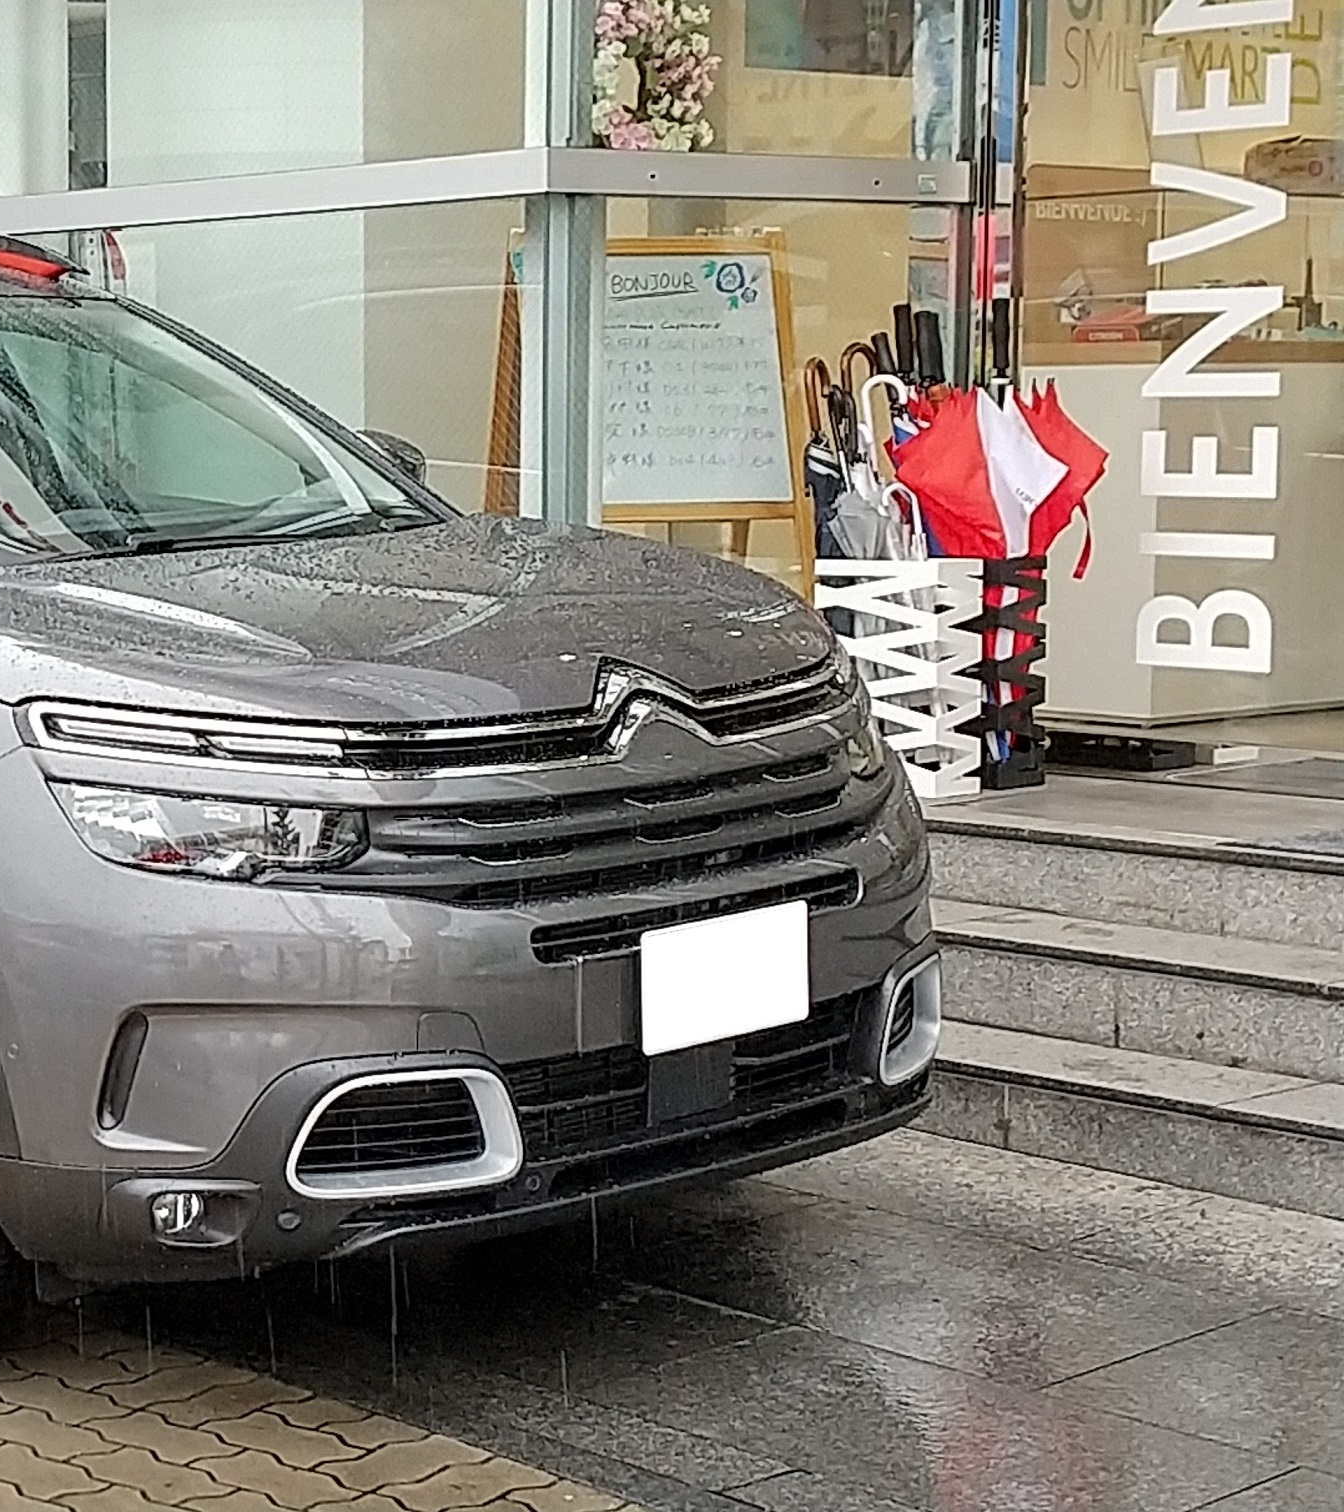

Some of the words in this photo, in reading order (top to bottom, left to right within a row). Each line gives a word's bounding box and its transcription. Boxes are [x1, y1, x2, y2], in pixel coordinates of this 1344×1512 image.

[1062, 27, 1152, 92] SMIL
[1163, 36, 1281, 103] MAR
[611, 272, 697, 295] BONJOUR
